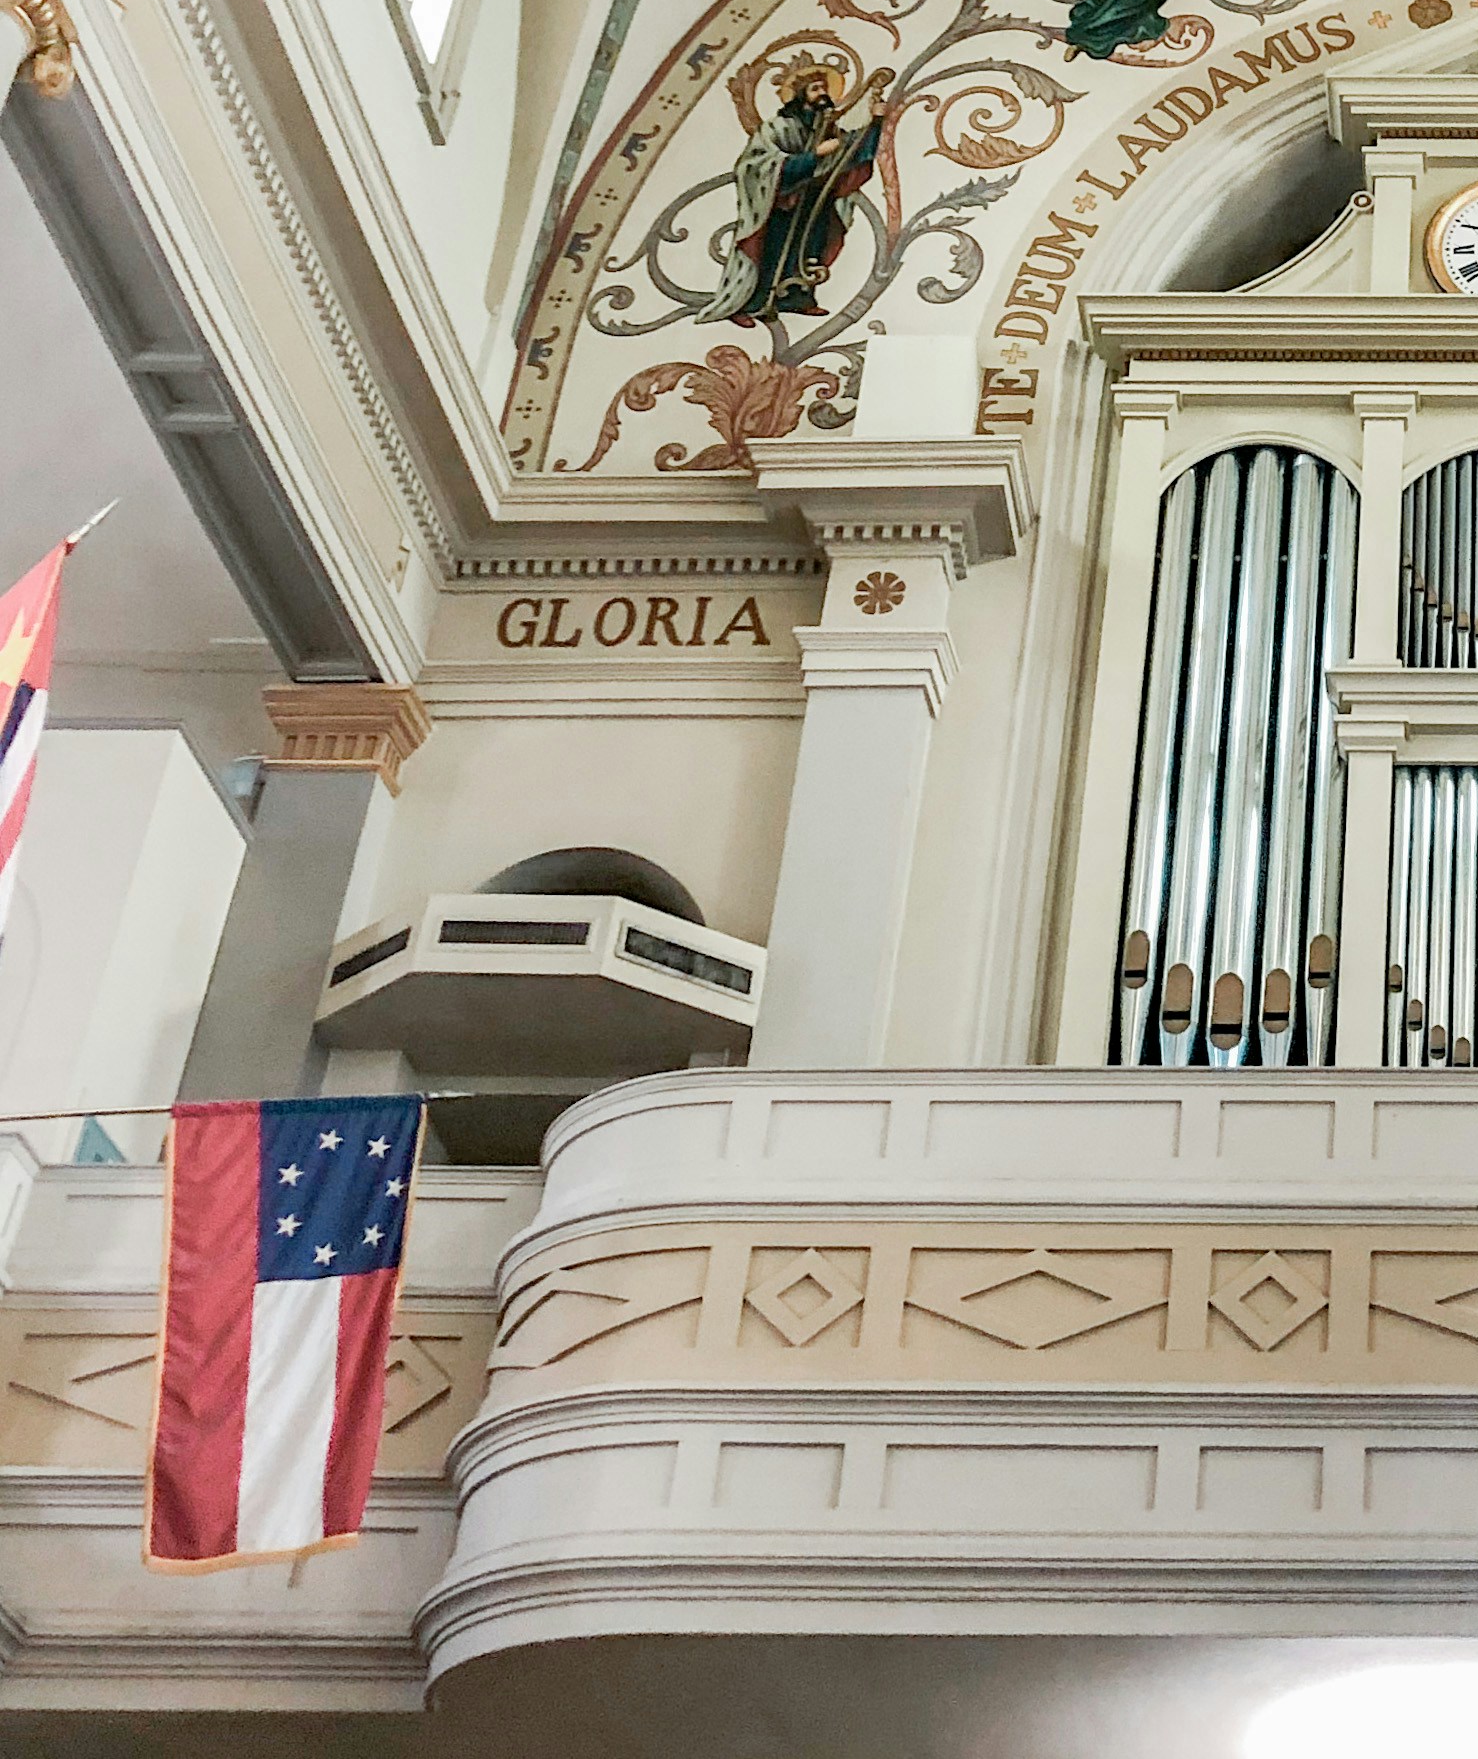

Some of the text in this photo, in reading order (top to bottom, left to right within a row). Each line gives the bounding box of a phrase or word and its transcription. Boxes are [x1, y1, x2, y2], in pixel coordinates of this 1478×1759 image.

[1077, 13, 1355, 201] LAUDAMUS
[995, 211, 1099, 345] DEUM
[976, 367, 1039, 435] TE
[496, 596, 771, 648] GLORIA
